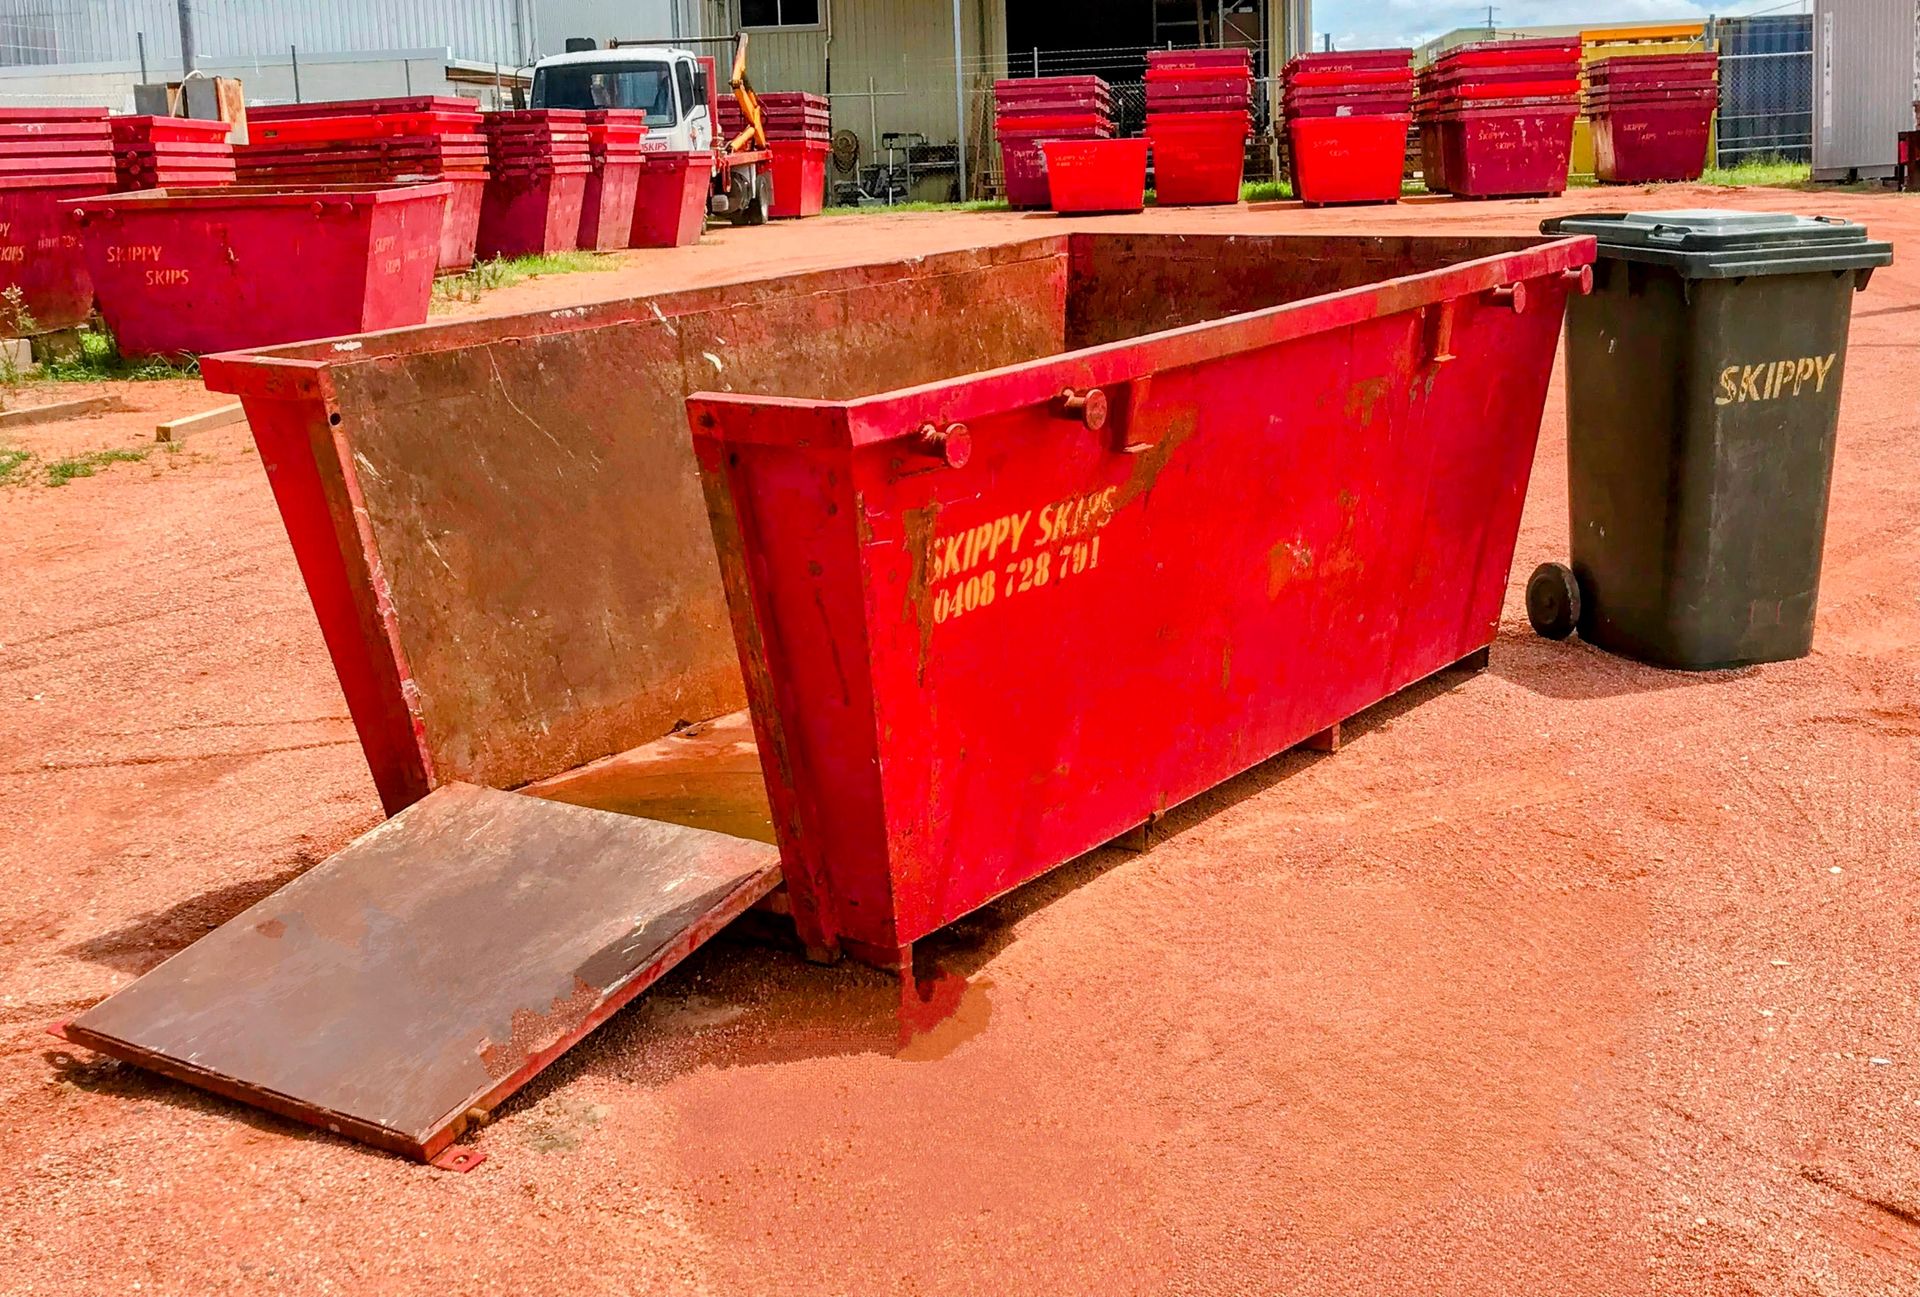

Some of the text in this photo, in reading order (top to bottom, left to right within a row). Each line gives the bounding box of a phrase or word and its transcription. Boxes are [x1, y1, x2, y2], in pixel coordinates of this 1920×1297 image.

[146, 269, 189, 286] SKIPS
[1714, 353, 1836, 405] SKIPPY
[928, 486, 1117, 585] SKIPPY SKIPS
[933, 536, 1100, 624] 0408 728 791
